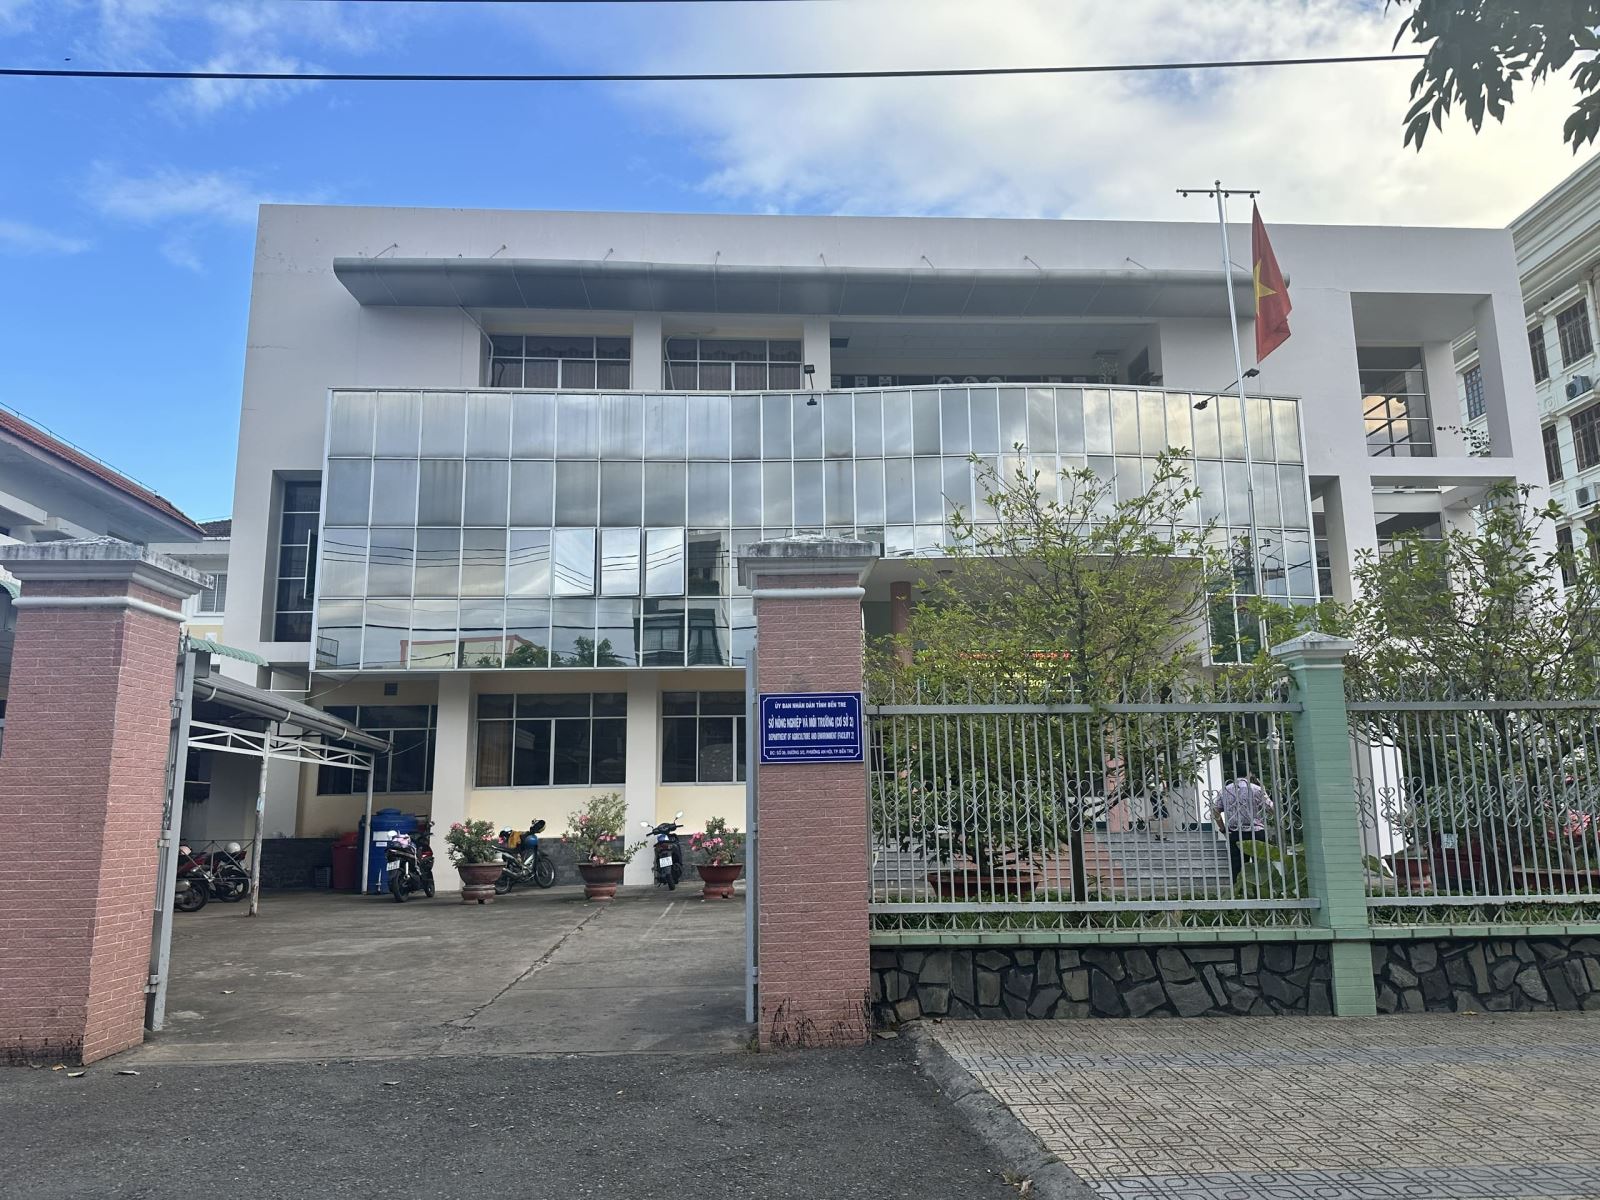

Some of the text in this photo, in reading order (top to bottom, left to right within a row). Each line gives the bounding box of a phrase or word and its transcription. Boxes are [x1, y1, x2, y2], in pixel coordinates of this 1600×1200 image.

[775, 701, 782, 709] ỦY
[768, 714, 774, 728] SỞ
[775, 716, 786, 728] NÔNG
[786, 715, 802, 730] NGHIỆP
[802, 715, 808, 728] VÀ
[808, 715, 817, 728] MÔI
[818, 714, 834, 728] TRƯỜNG
[842, 713, 849, 727] SỞ
